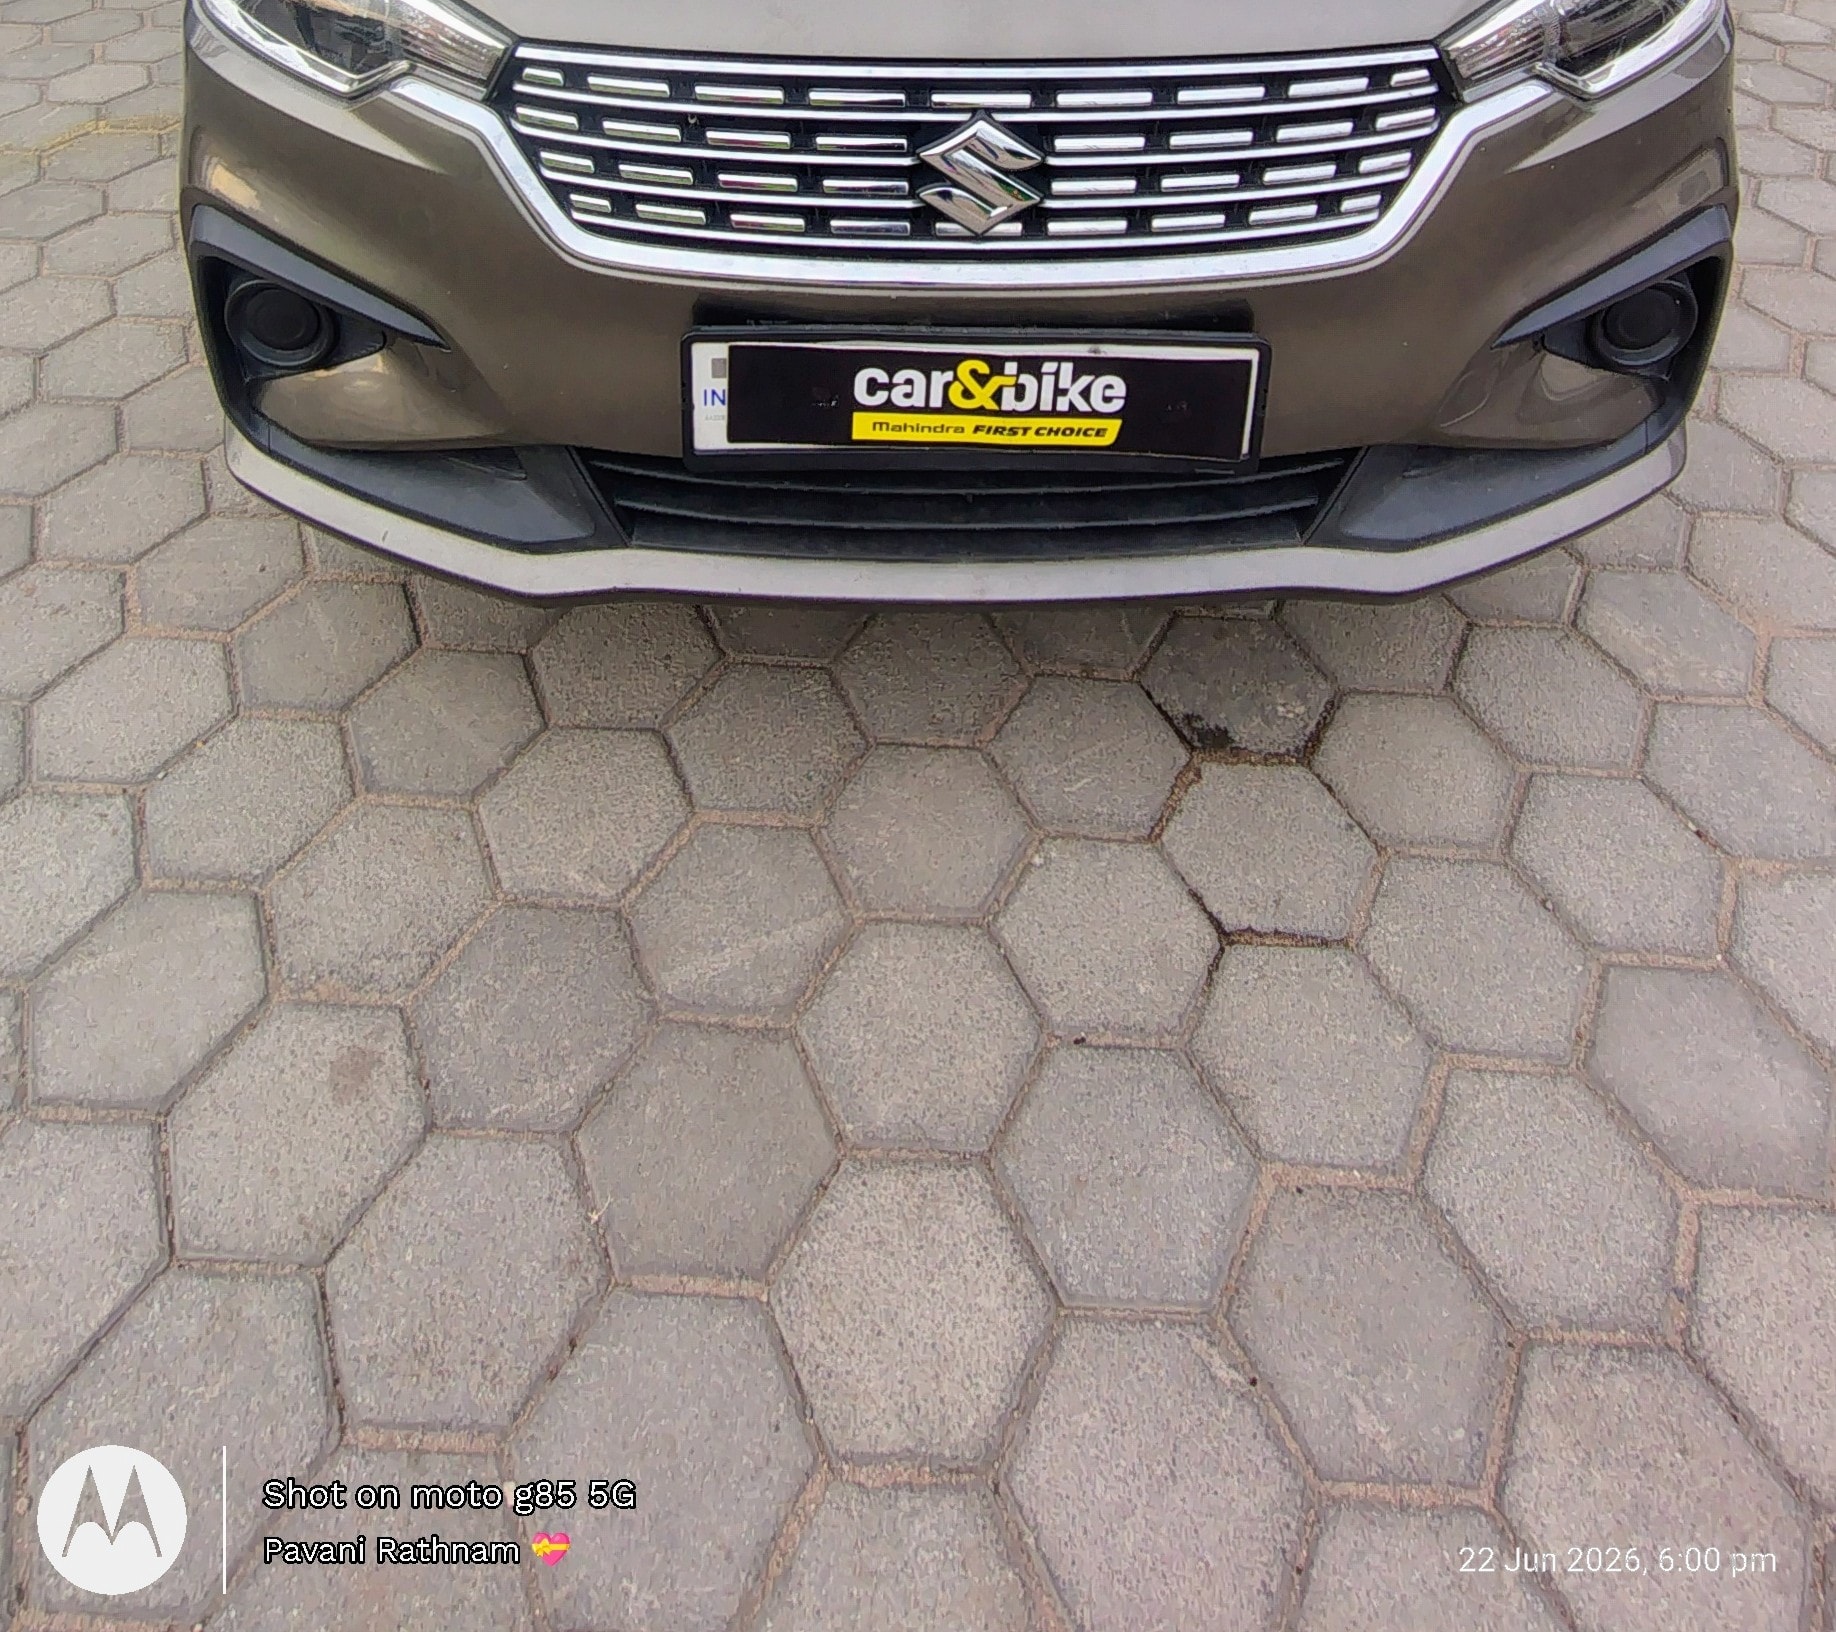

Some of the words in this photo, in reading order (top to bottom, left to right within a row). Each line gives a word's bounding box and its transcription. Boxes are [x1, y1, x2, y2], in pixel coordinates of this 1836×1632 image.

[853, 359, 1127, 413] car&bike
[704, 389, 726, 406] IN
[872, 421, 965, 434] Mahindra
[972, 424, 1031, 436] FIRST
[1034, 426, 1108, 437] CHOICE
